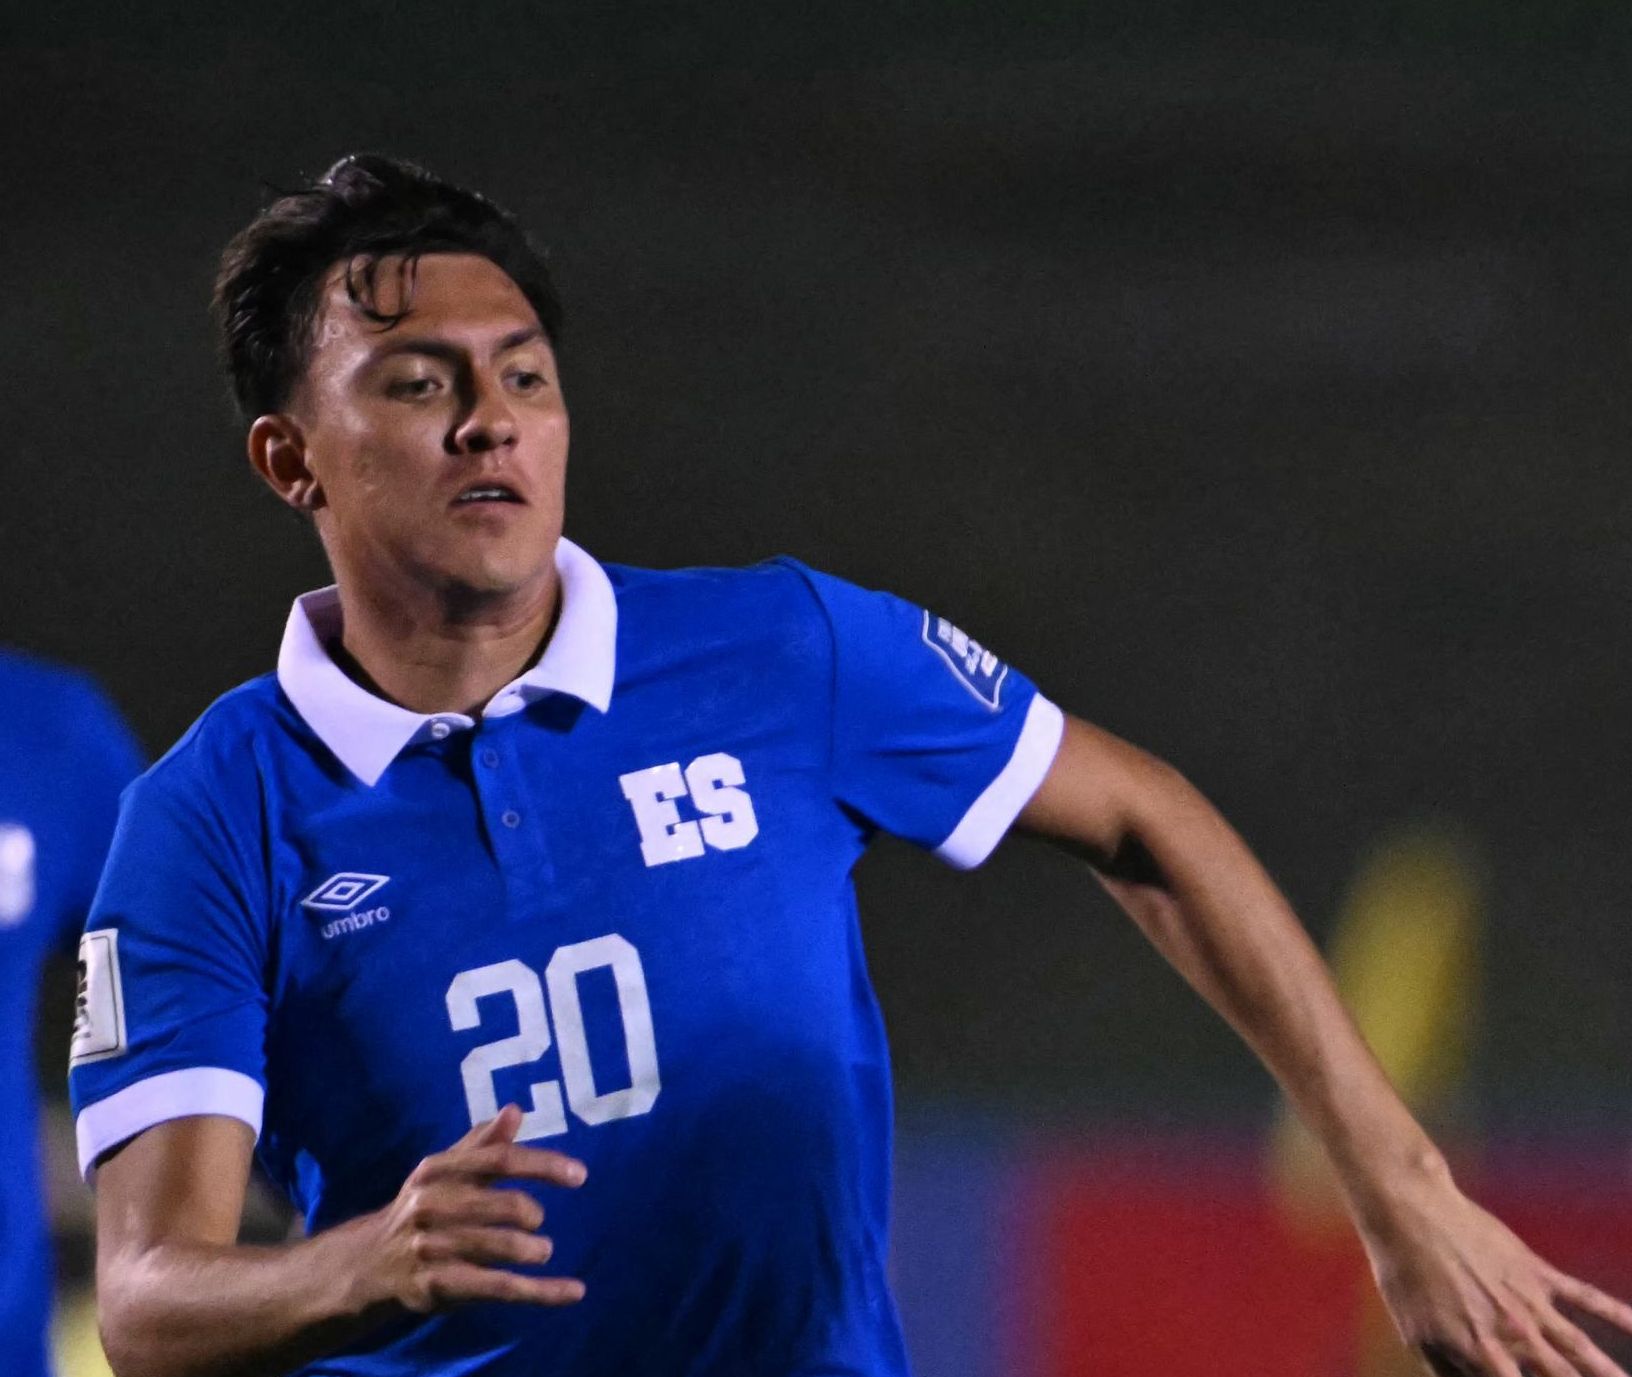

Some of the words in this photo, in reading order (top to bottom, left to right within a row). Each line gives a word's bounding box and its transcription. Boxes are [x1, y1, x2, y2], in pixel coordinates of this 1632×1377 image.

[618, 752, 760, 867] ES
[321, 906, 390, 939] umbro
[445, 932, 661, 1142] 20
